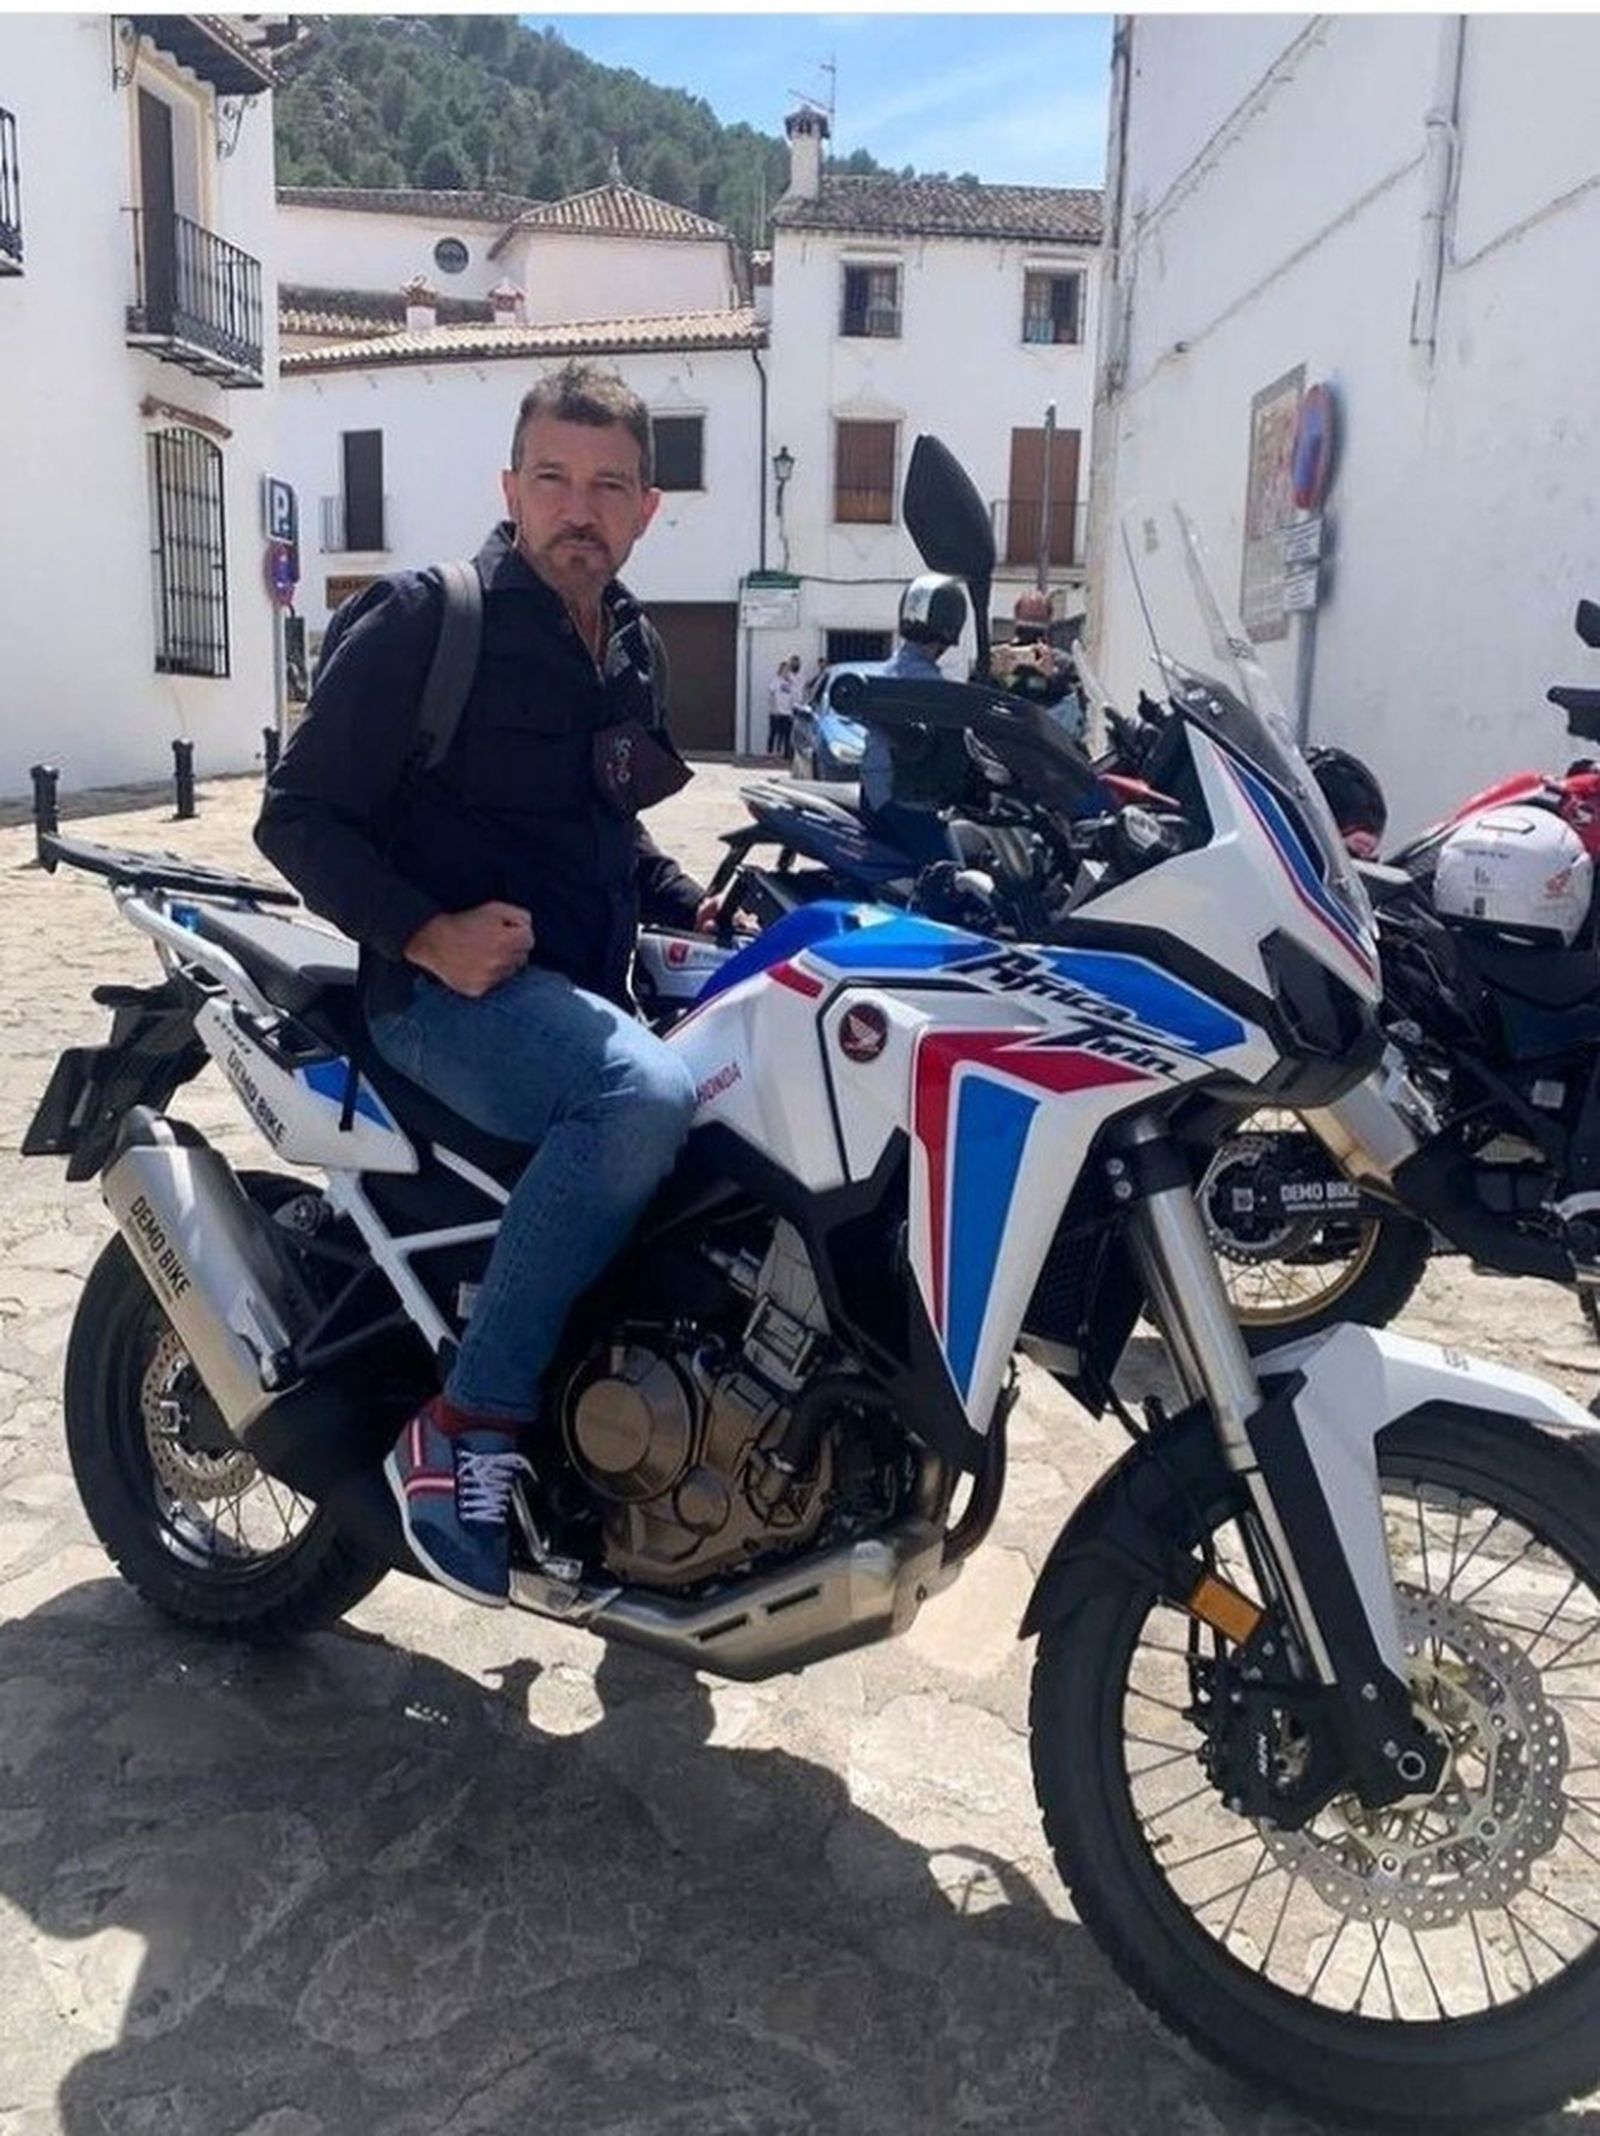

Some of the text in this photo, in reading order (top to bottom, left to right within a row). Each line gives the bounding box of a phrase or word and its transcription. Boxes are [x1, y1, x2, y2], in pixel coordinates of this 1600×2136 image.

[273, 486, 289, 533] P
[943, 949, 1131, 1022] Africa
[1027, 1015, 1182, 1074] Twin
[227, 1049, 258, 1102] DEMO
[256, 1096, 287, 1143] BIKE
[695, 1061, 742, 1107] HONDA
[1280, 1181, 1360, 1202] DEMO BIKE
[130, 1196, 166, 1252] DEMO
[158, 1249, 191, 1299] BIKE
